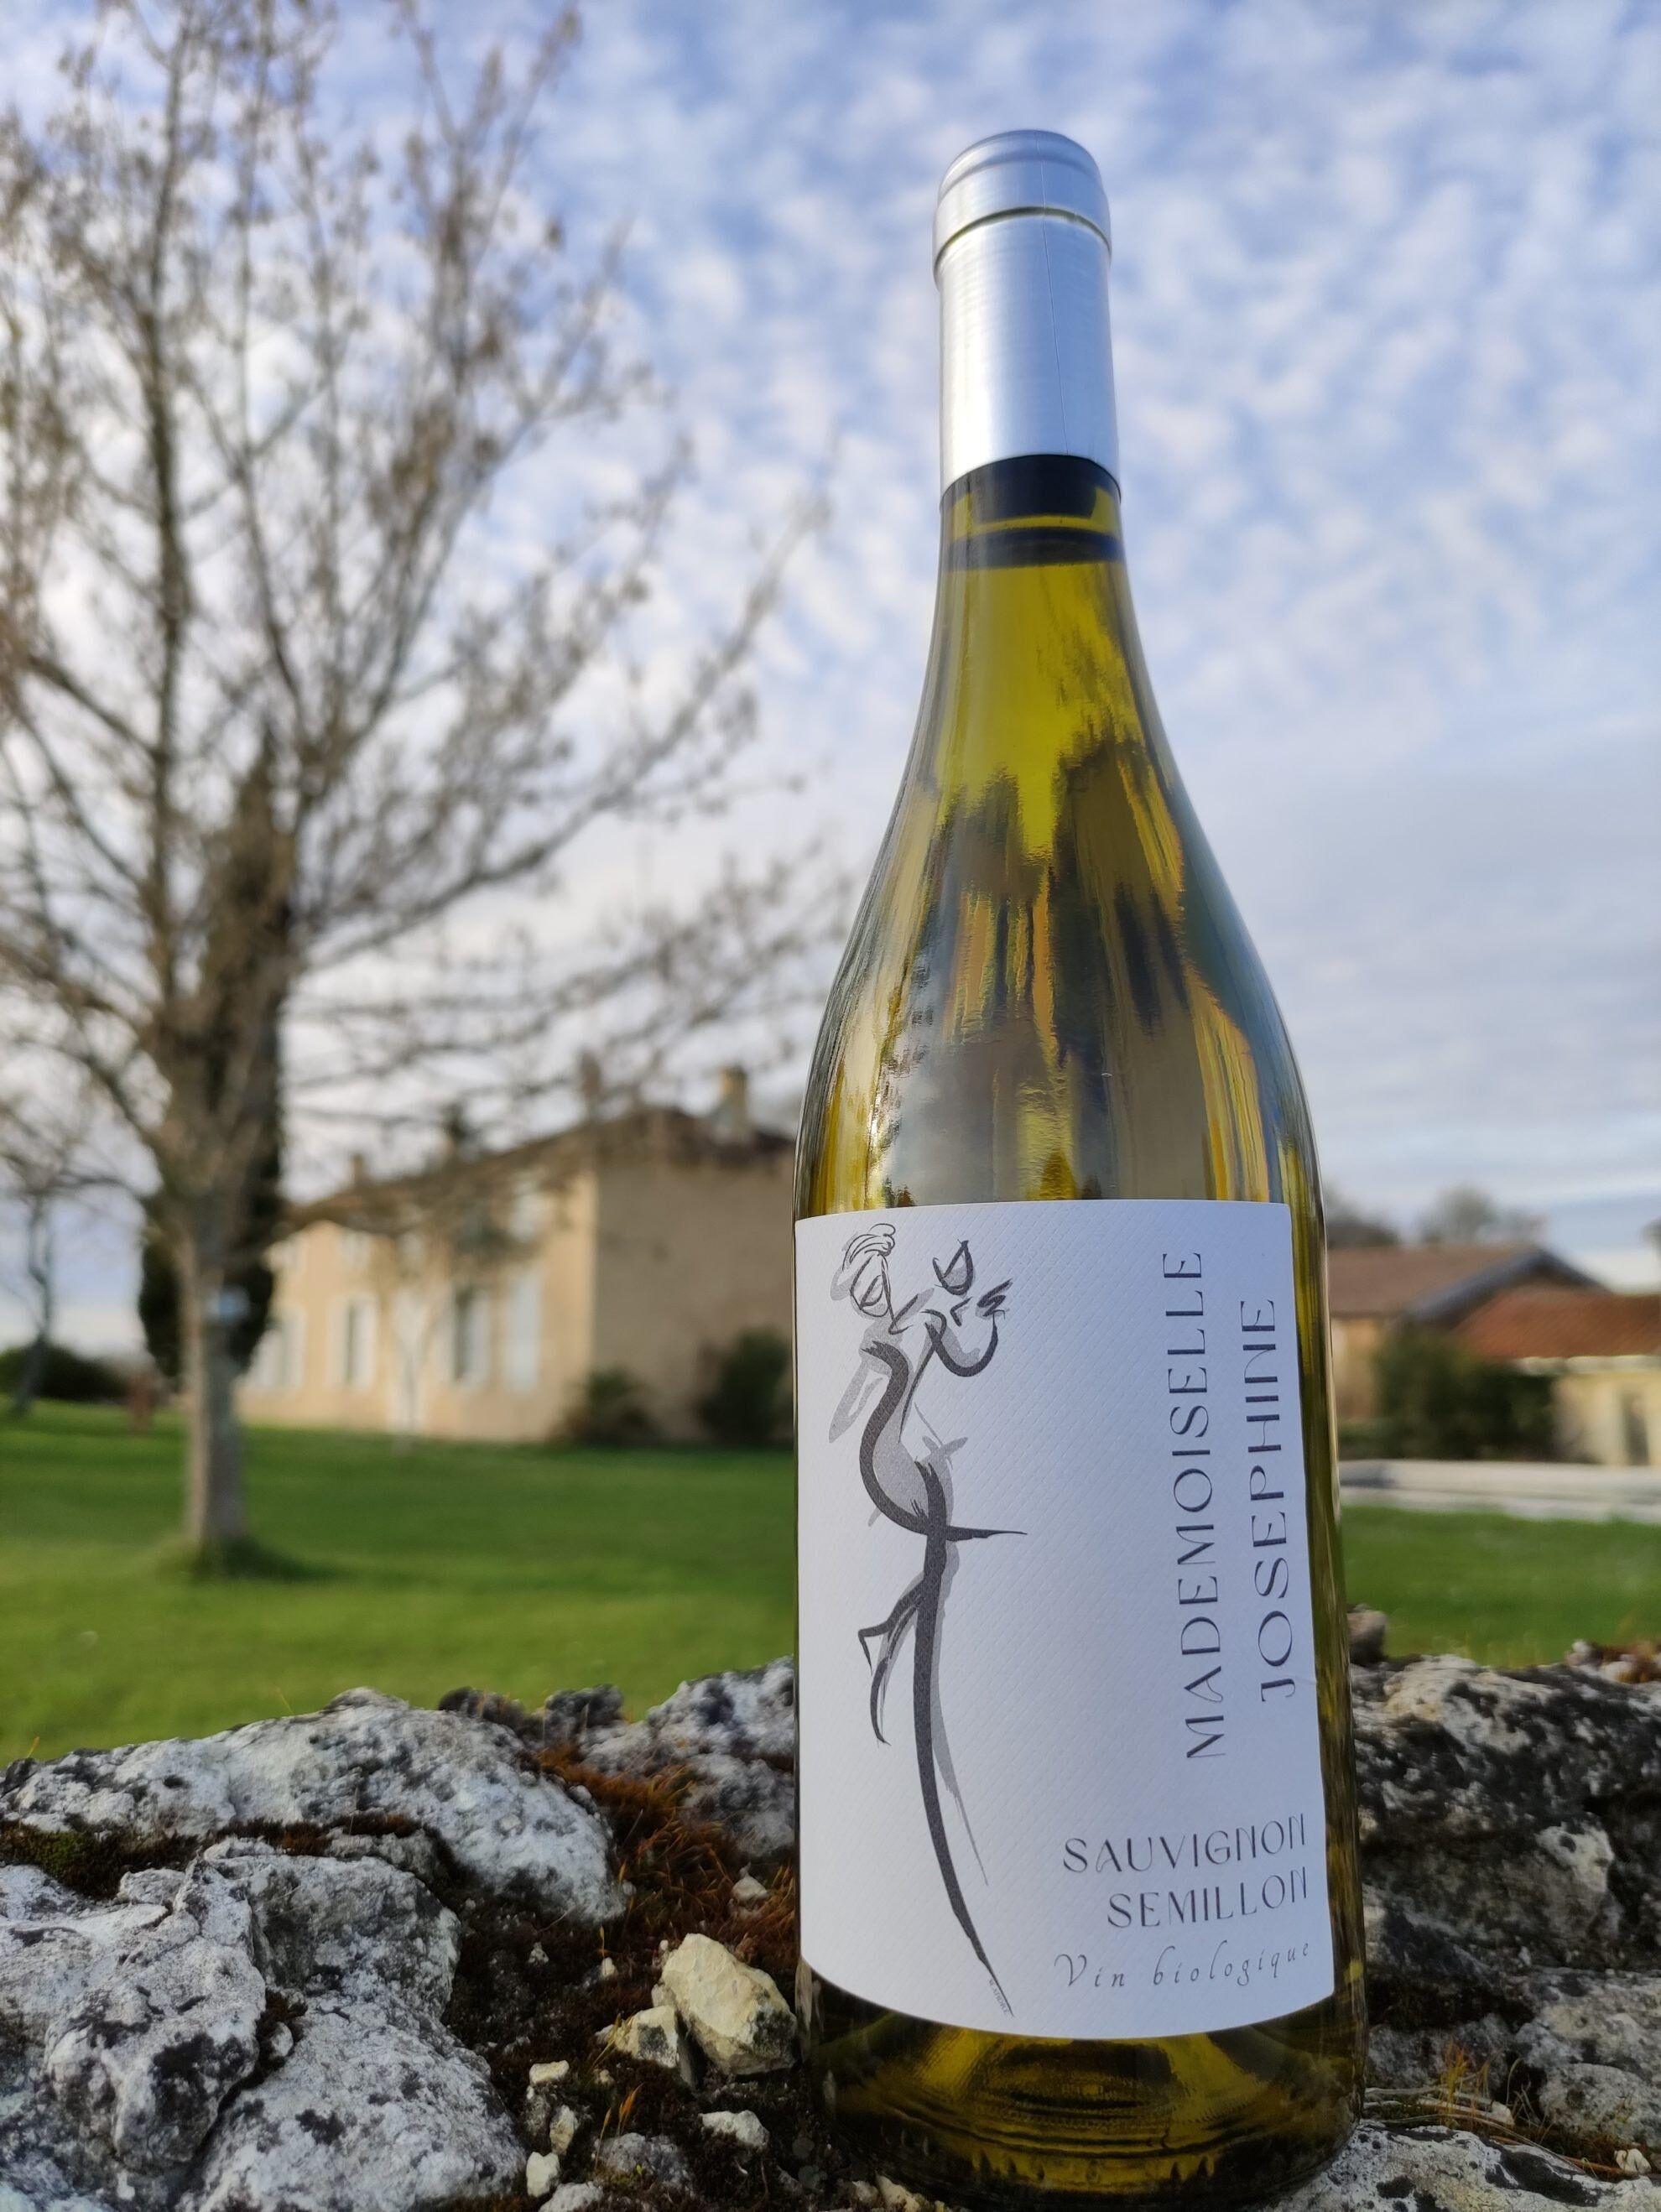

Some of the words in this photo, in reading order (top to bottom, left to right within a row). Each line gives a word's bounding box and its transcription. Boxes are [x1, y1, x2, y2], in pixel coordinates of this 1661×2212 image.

[1163, 1252, 1225, 1758] MADEMOISELLE
[1241, 1300, 1295, 1702] JOSEPHINE
[1063, 1814, 1305, 1873] SAUVIGNON
[1107, 1867, 1307, 1928] SEMILLON
[1054, 1954, 1125, 1988] Vin
[1153, 1940, 1309, 1986] biologique
